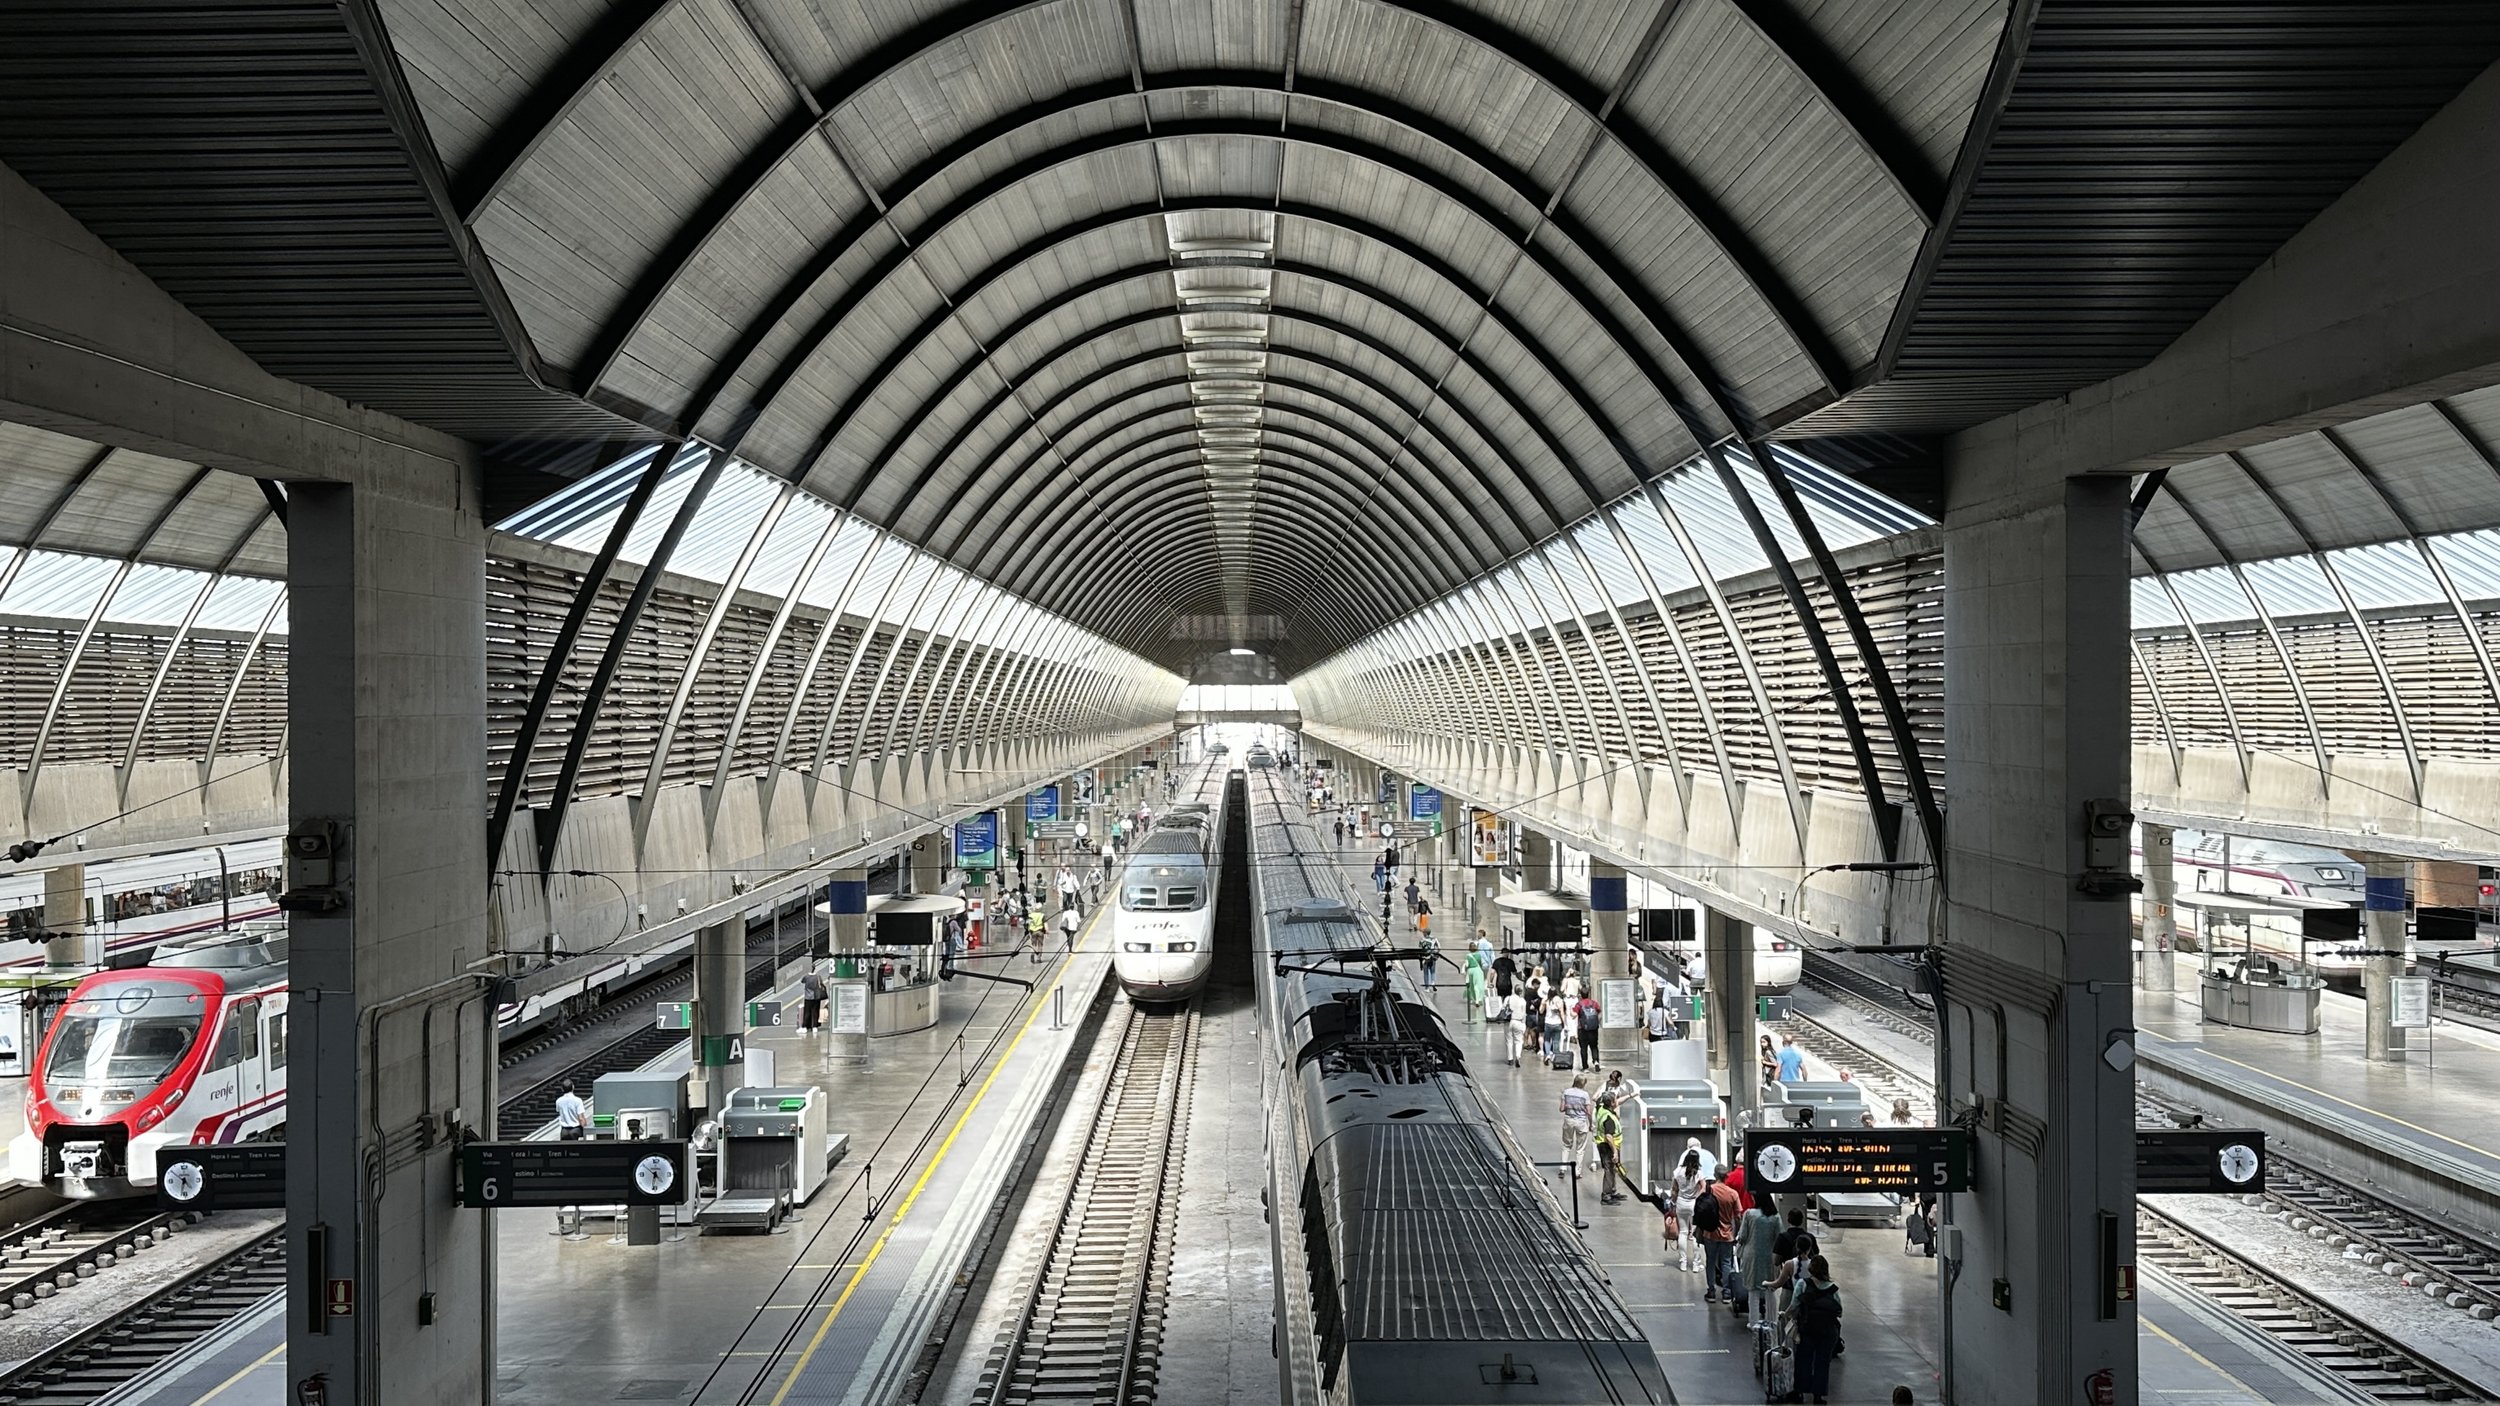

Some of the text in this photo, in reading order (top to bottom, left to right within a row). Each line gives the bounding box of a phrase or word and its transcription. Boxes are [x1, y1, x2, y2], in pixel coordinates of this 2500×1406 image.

[658, 1015, 667, 1028] 7
[772, 1013, 781, 1026] 6
[1671, 1007, 1679, 1020] 5
[1781, 1008, 1791, 1020] 4
[729, 1038, 744, 1060] A
[210, 1080, 234, 1102] renfe
[1932, 1162, 1948, 1186] 5
[482, 1177, 498, 1201] 6
